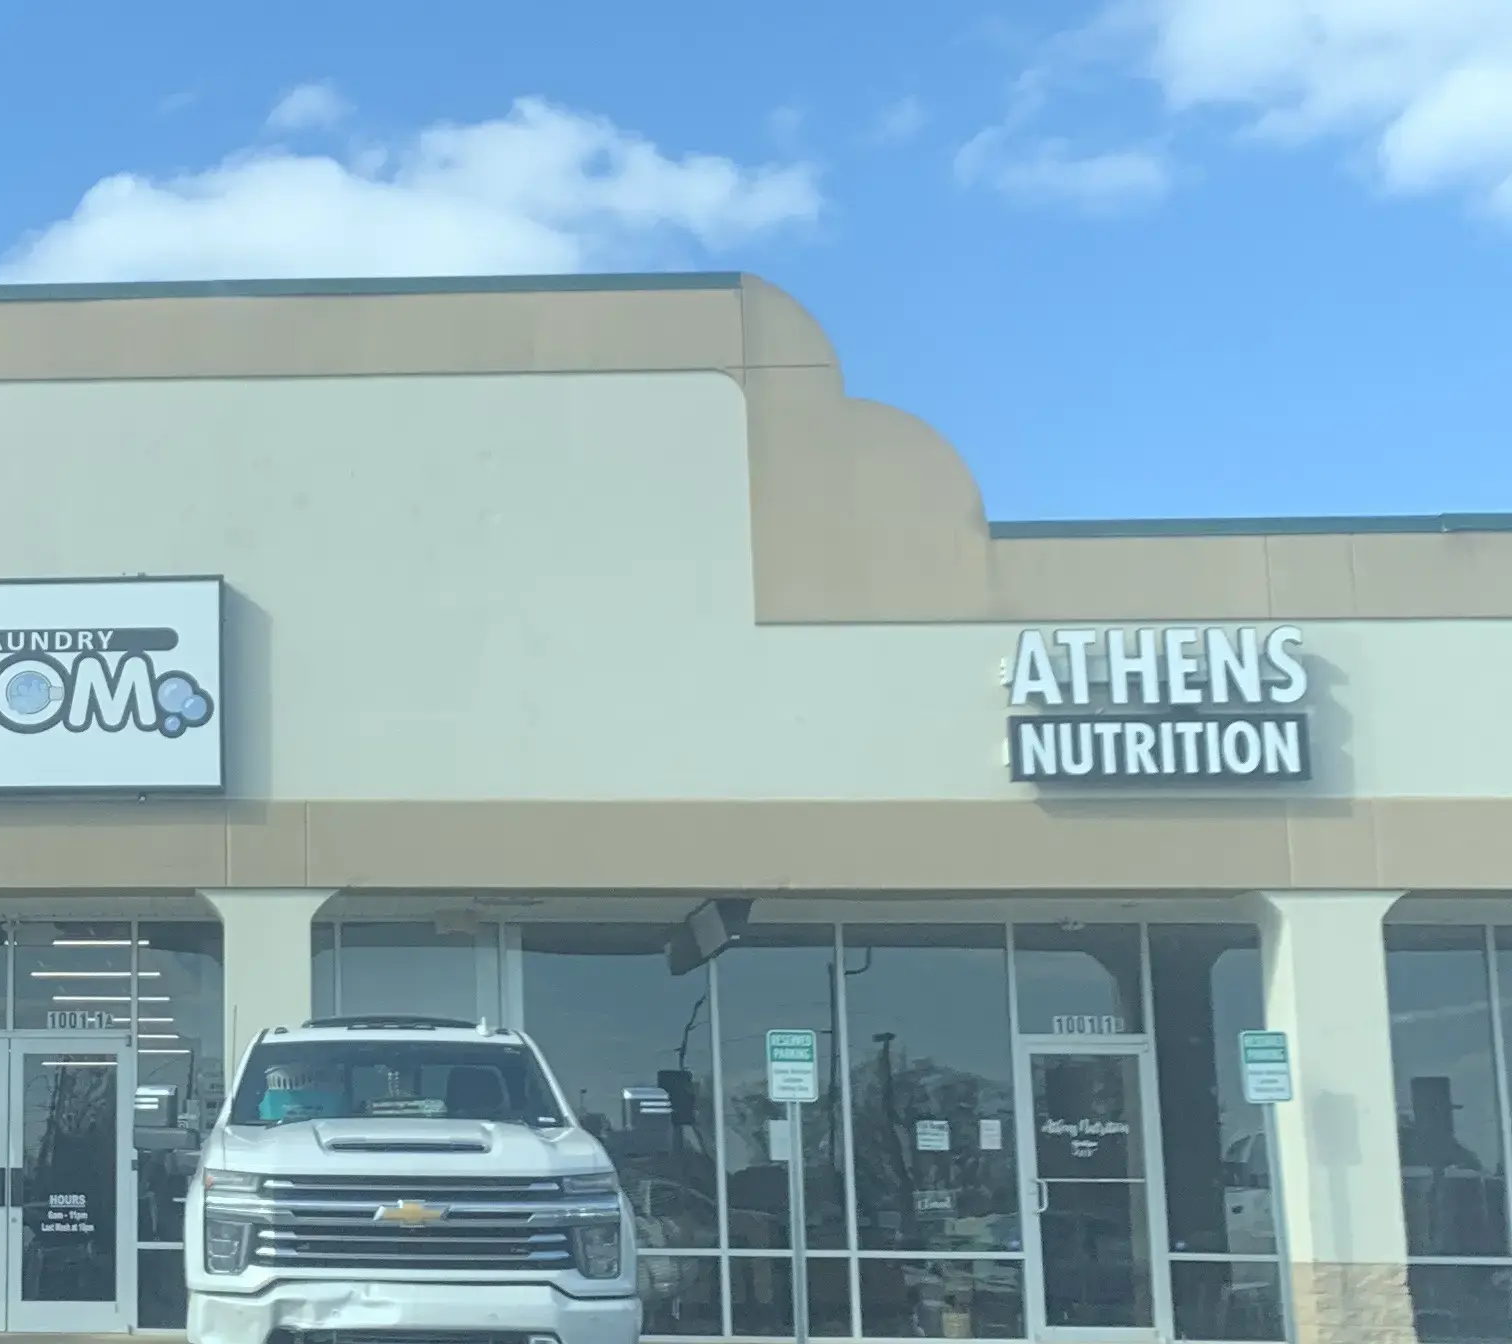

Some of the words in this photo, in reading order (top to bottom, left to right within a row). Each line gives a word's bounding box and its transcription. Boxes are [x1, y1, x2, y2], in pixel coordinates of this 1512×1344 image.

[1009, 625, 1308, 706] ATHENS
[1018, 720, 1302, 776] NUTRITION
[49, 1194, 86, 1205] HOURS
